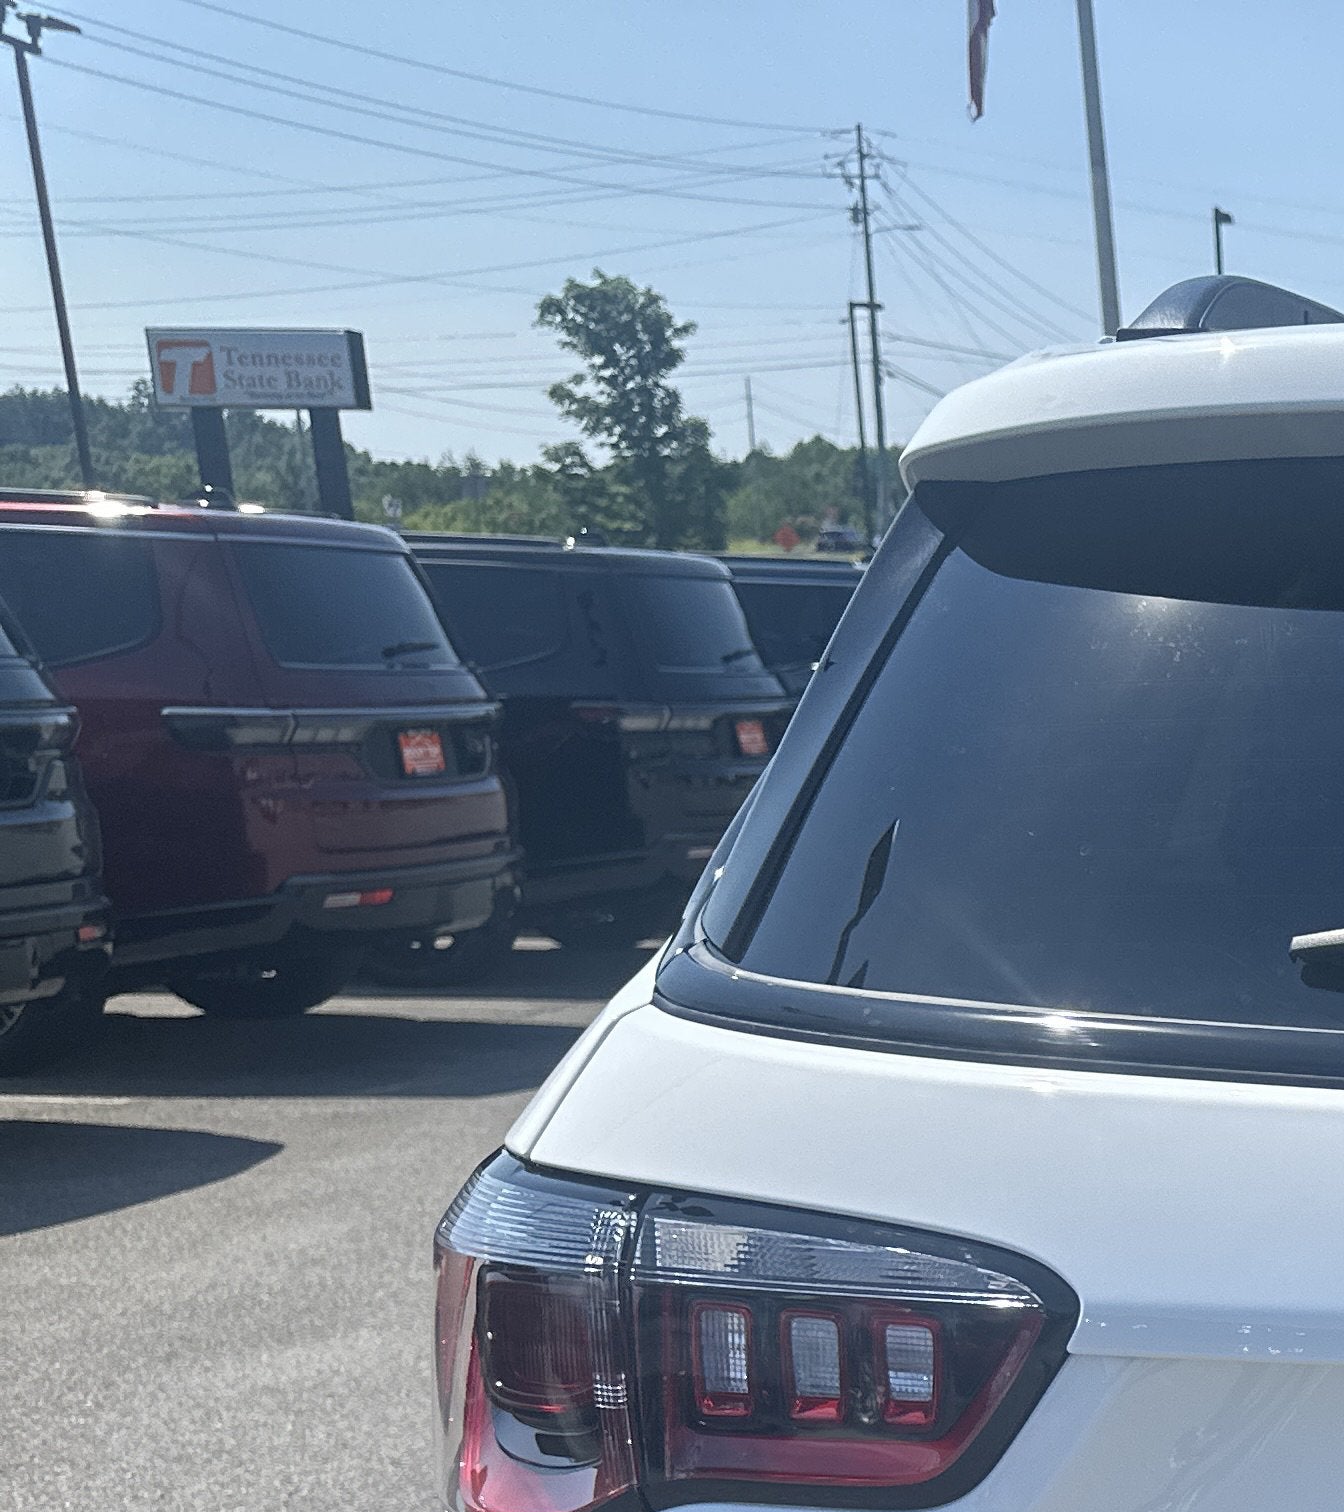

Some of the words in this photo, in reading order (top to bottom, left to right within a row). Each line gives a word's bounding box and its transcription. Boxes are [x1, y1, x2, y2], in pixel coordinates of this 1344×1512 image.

[220, 346, 343, 368] Tennessee
[222, 370, 279, 390] State
[285, 369, 345, 393] Bank
